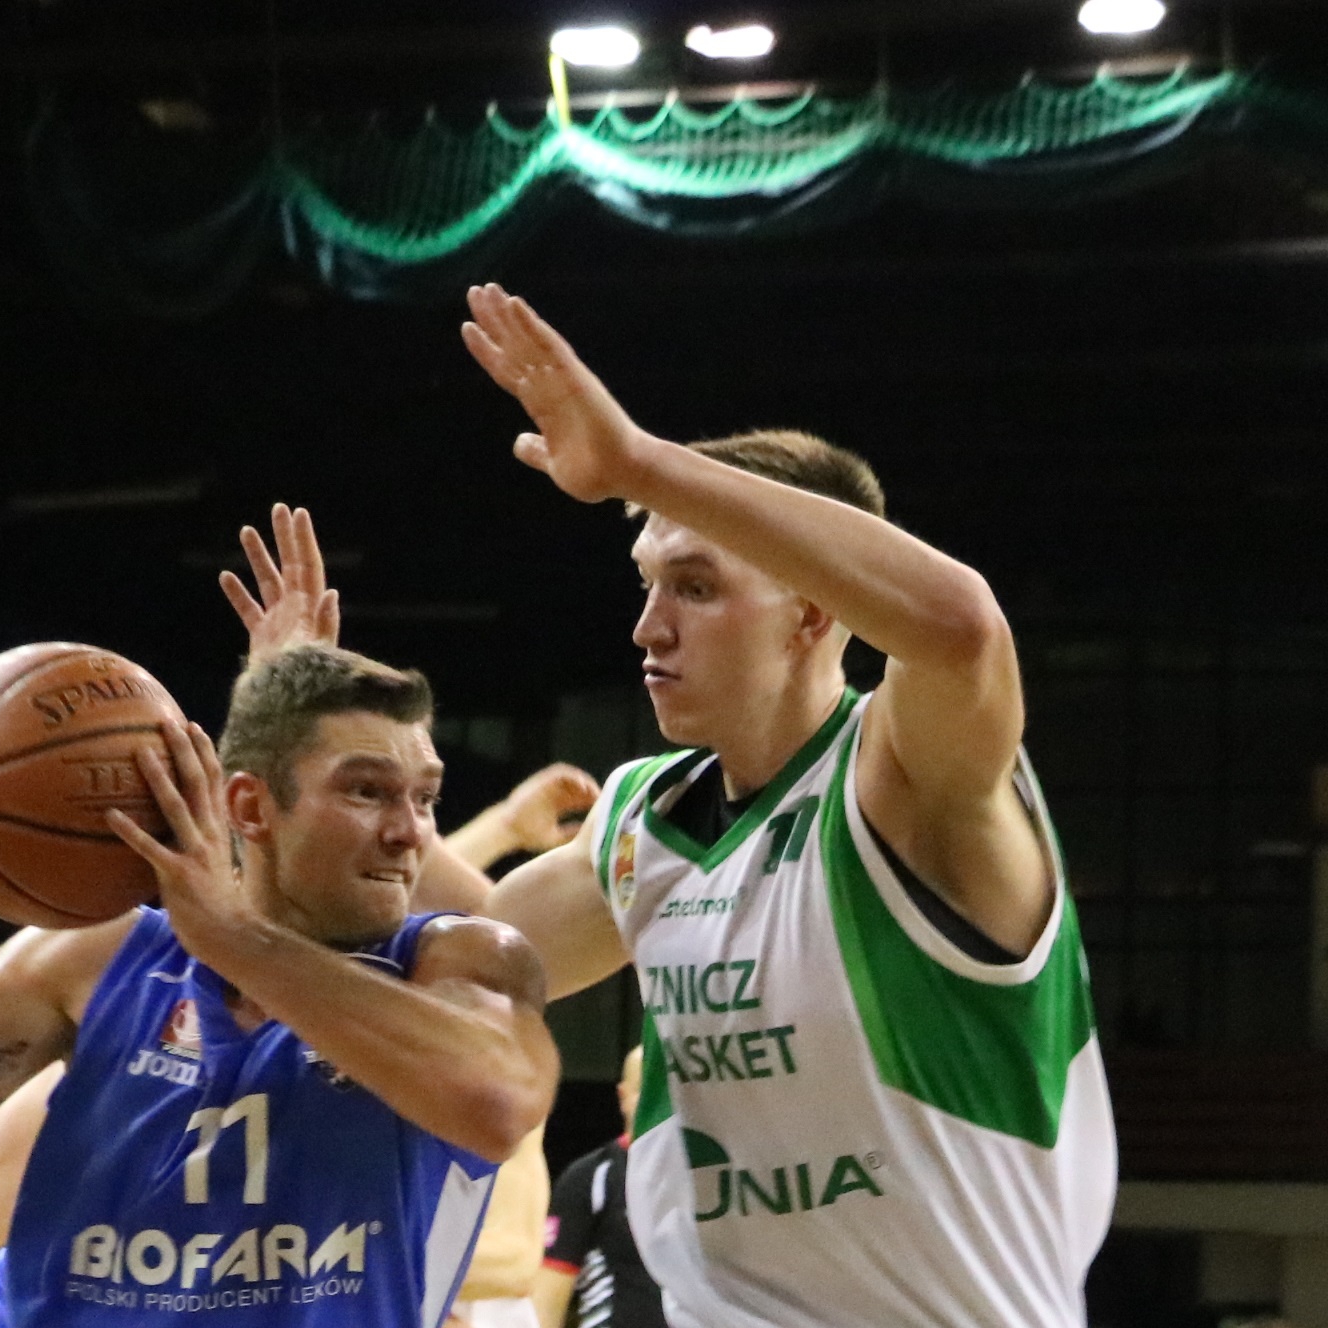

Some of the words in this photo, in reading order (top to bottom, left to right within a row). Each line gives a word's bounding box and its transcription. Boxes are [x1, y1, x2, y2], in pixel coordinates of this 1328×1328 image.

[646, 959, 761, 1016] ZNICZ
[128, 1050, 202, 1087] Jom
[668, 1024, 797, 1083] ASKET
[66, 1281, 137, 1308] POLSKI
[144, 1286, 283, 1313] PRODUCENT
[291, 1276, 363, 1304] LEKÓW
